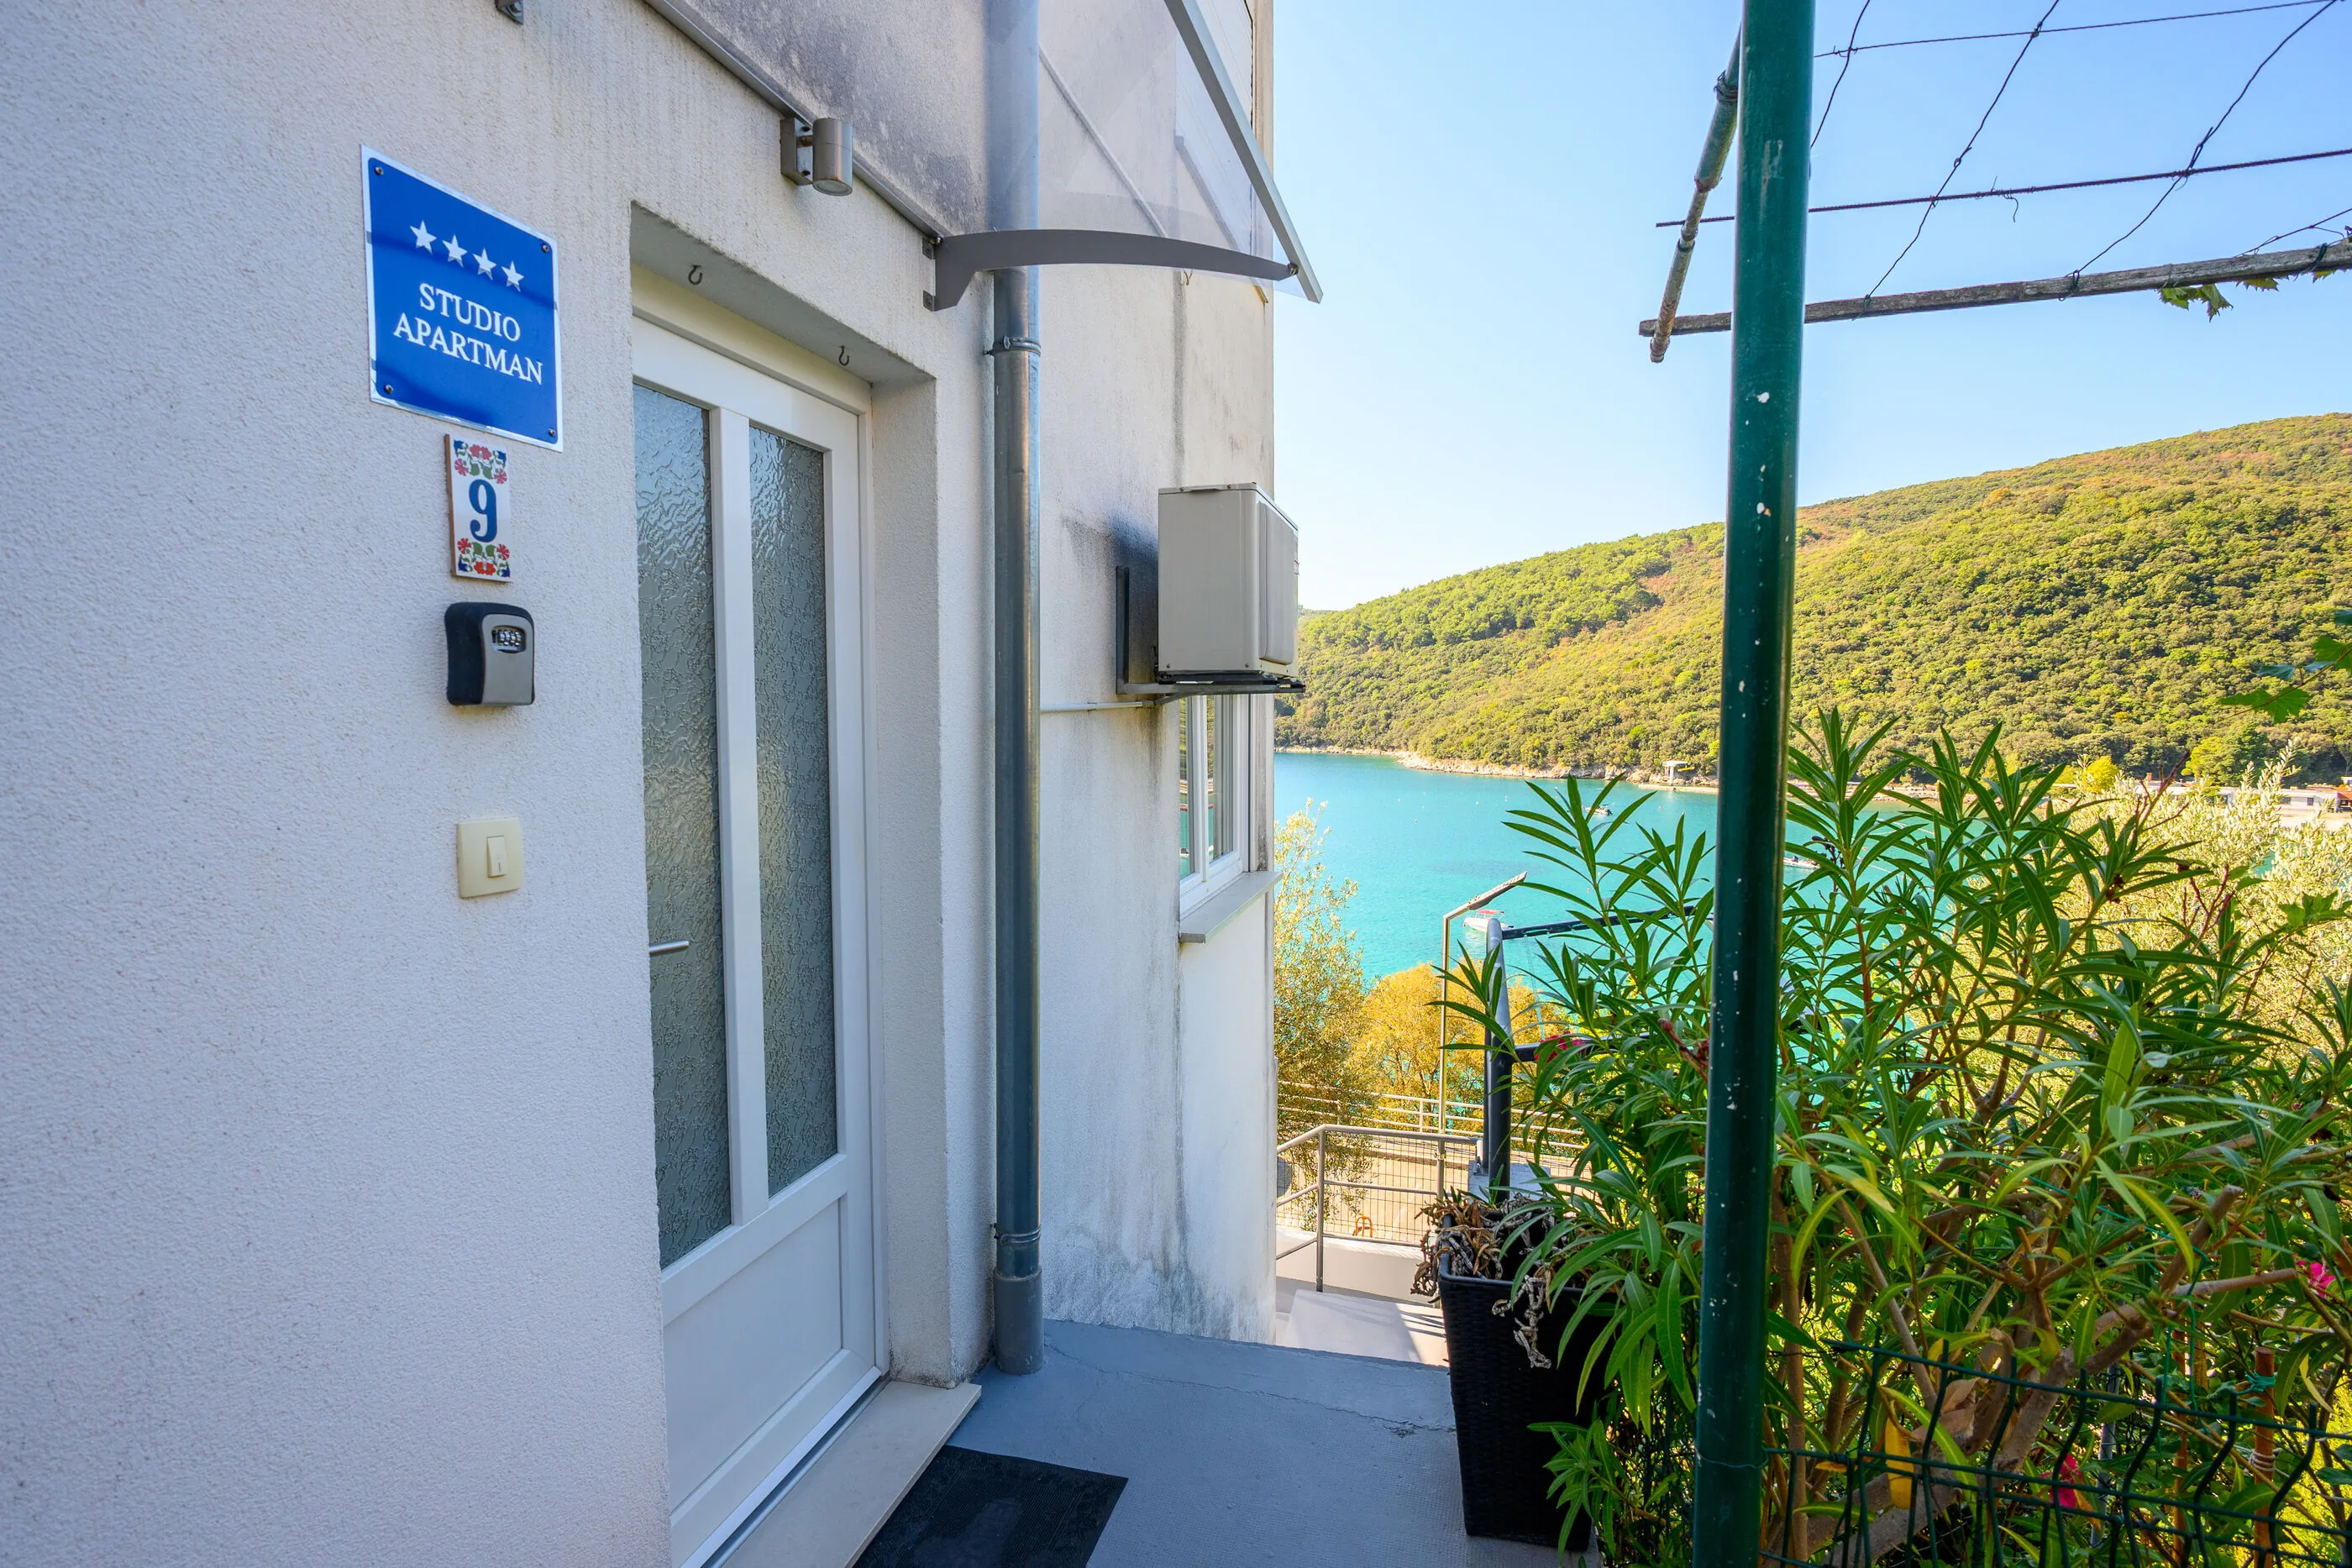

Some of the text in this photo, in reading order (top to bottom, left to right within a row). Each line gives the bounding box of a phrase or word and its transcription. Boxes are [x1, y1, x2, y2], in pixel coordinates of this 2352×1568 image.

[419, 283, 521, 341] STUDIO
[393, 312, 543, 385] APARTMAN
[469, 478, 497, 543] 9
